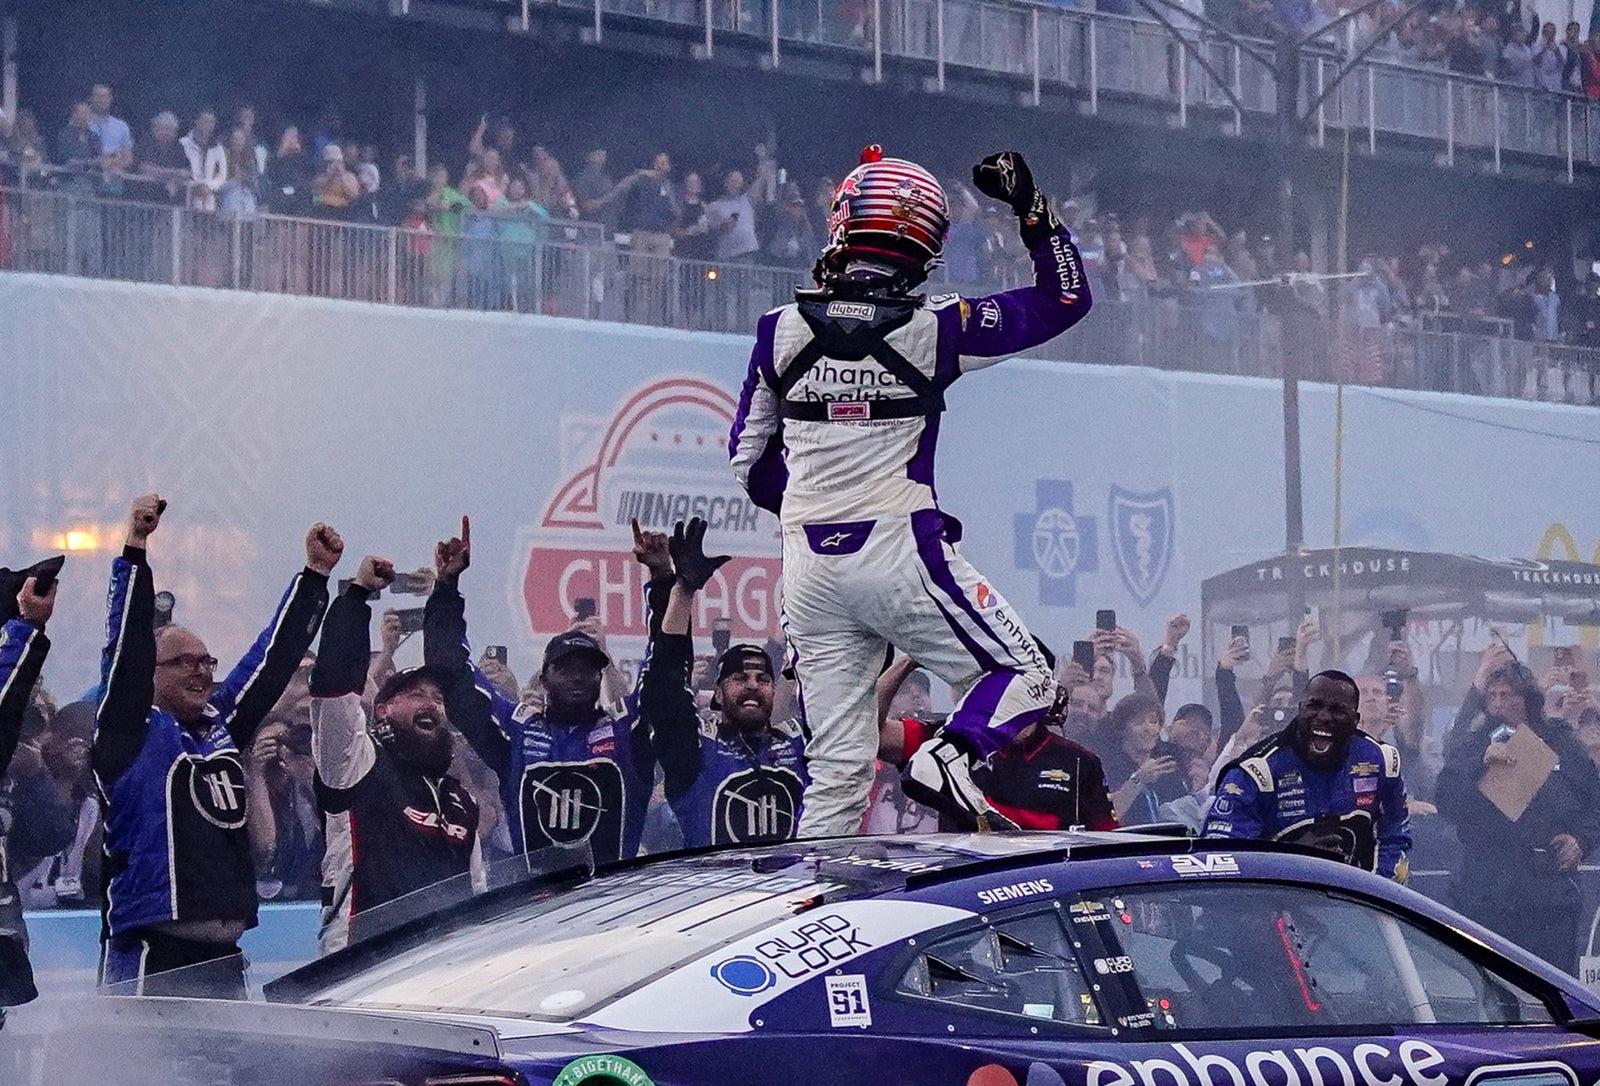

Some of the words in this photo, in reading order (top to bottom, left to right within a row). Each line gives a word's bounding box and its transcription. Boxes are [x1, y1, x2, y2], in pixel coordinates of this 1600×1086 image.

[832, 304, 870, 317] Hybrid
[806, 361, 904, 385] nhanc
[833, 406, 864, 415] SIMPSON
[652, 492, 759, 531] NASCAR
[1257, 558, 1410, 581] TRCKHOUSE
[559, 558, 784, 630] CHIAG
[1170, 854, 1239, 873] SVG
[977, 879, 1054, 905] SIEMENS
[755, 914, 851, 959] QUAD
[775, 928, 873, 978] LOCK
[832, 989, 867, 1015] 91
